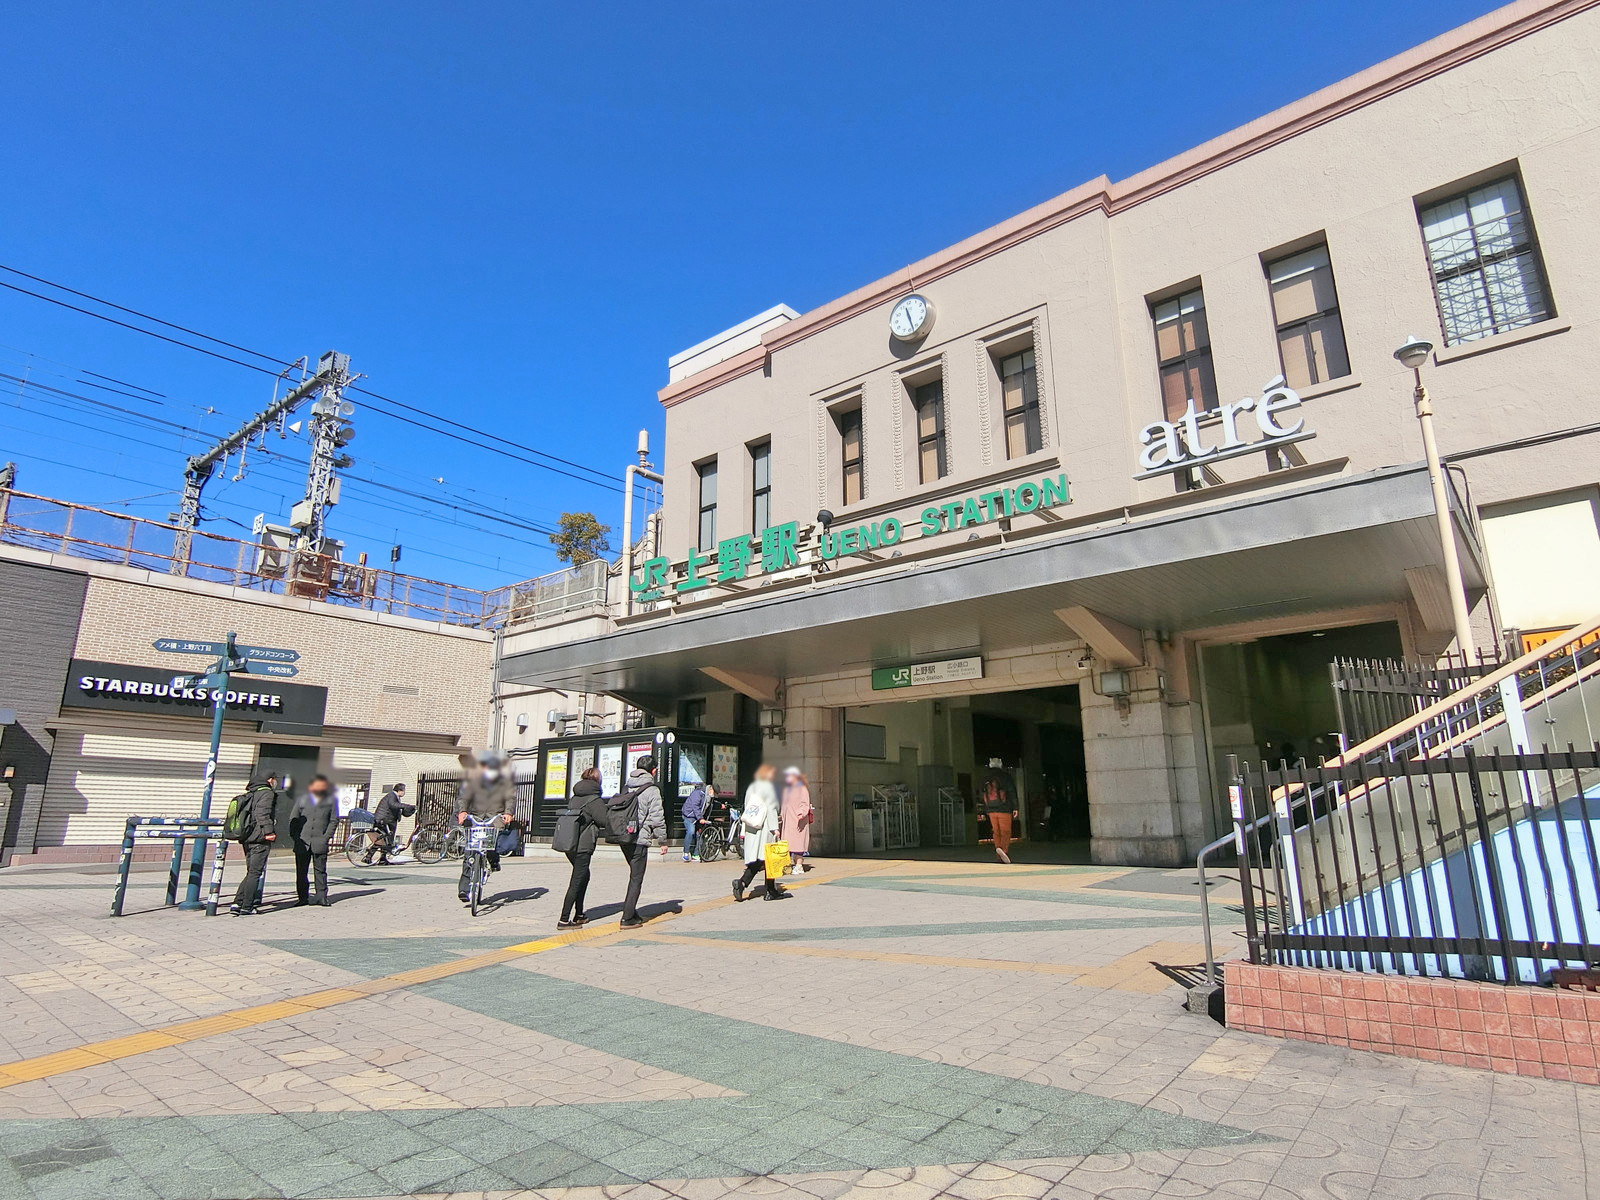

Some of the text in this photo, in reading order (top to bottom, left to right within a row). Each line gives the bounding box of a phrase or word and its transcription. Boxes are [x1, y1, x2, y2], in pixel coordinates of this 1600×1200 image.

[1138, 374, 1305, 470] atré
[630, 473, 1070, 592] JR 上野駅 UENO STATION
[249, 648, 295, 660] グランドコンコース
[267, 665, 293, 675] 中央改札
[892, 669, 910, 681] JR
[913, 665, 936, 676] 上野駅
[79, 676, 281, 708] STARBUCKS COFFEE
